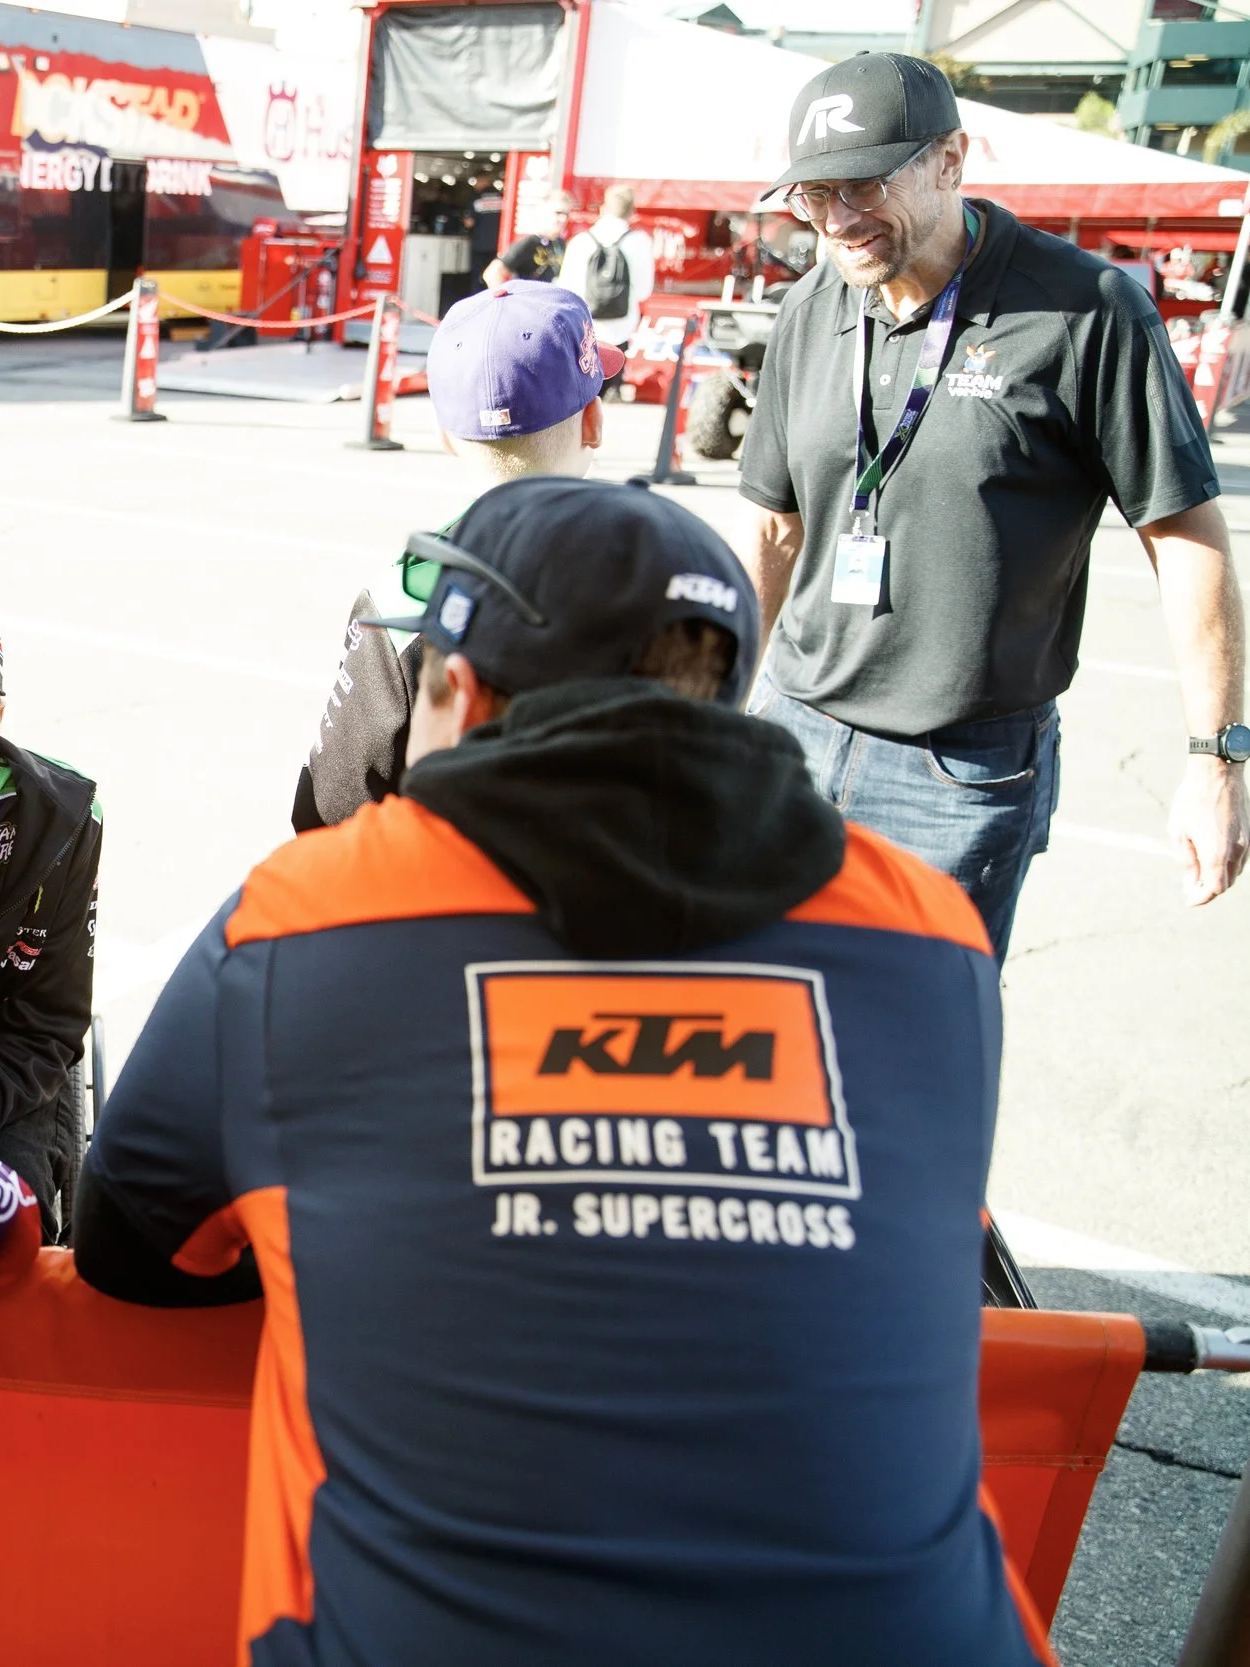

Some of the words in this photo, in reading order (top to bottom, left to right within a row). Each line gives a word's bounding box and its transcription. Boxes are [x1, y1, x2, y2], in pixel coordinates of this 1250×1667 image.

[945, 373, 1003, 390] TEAM
[665, 573, 738, 612] KTM
[537, 1013, 775, 1081] KTM
[490, 1118, 686, 1167] RACING
[709, 1121, 844, 1179] TEAM
[491, 1193, 557, 1237] JR.
[573, 1193, 856, 1251] SUPERCROSS
